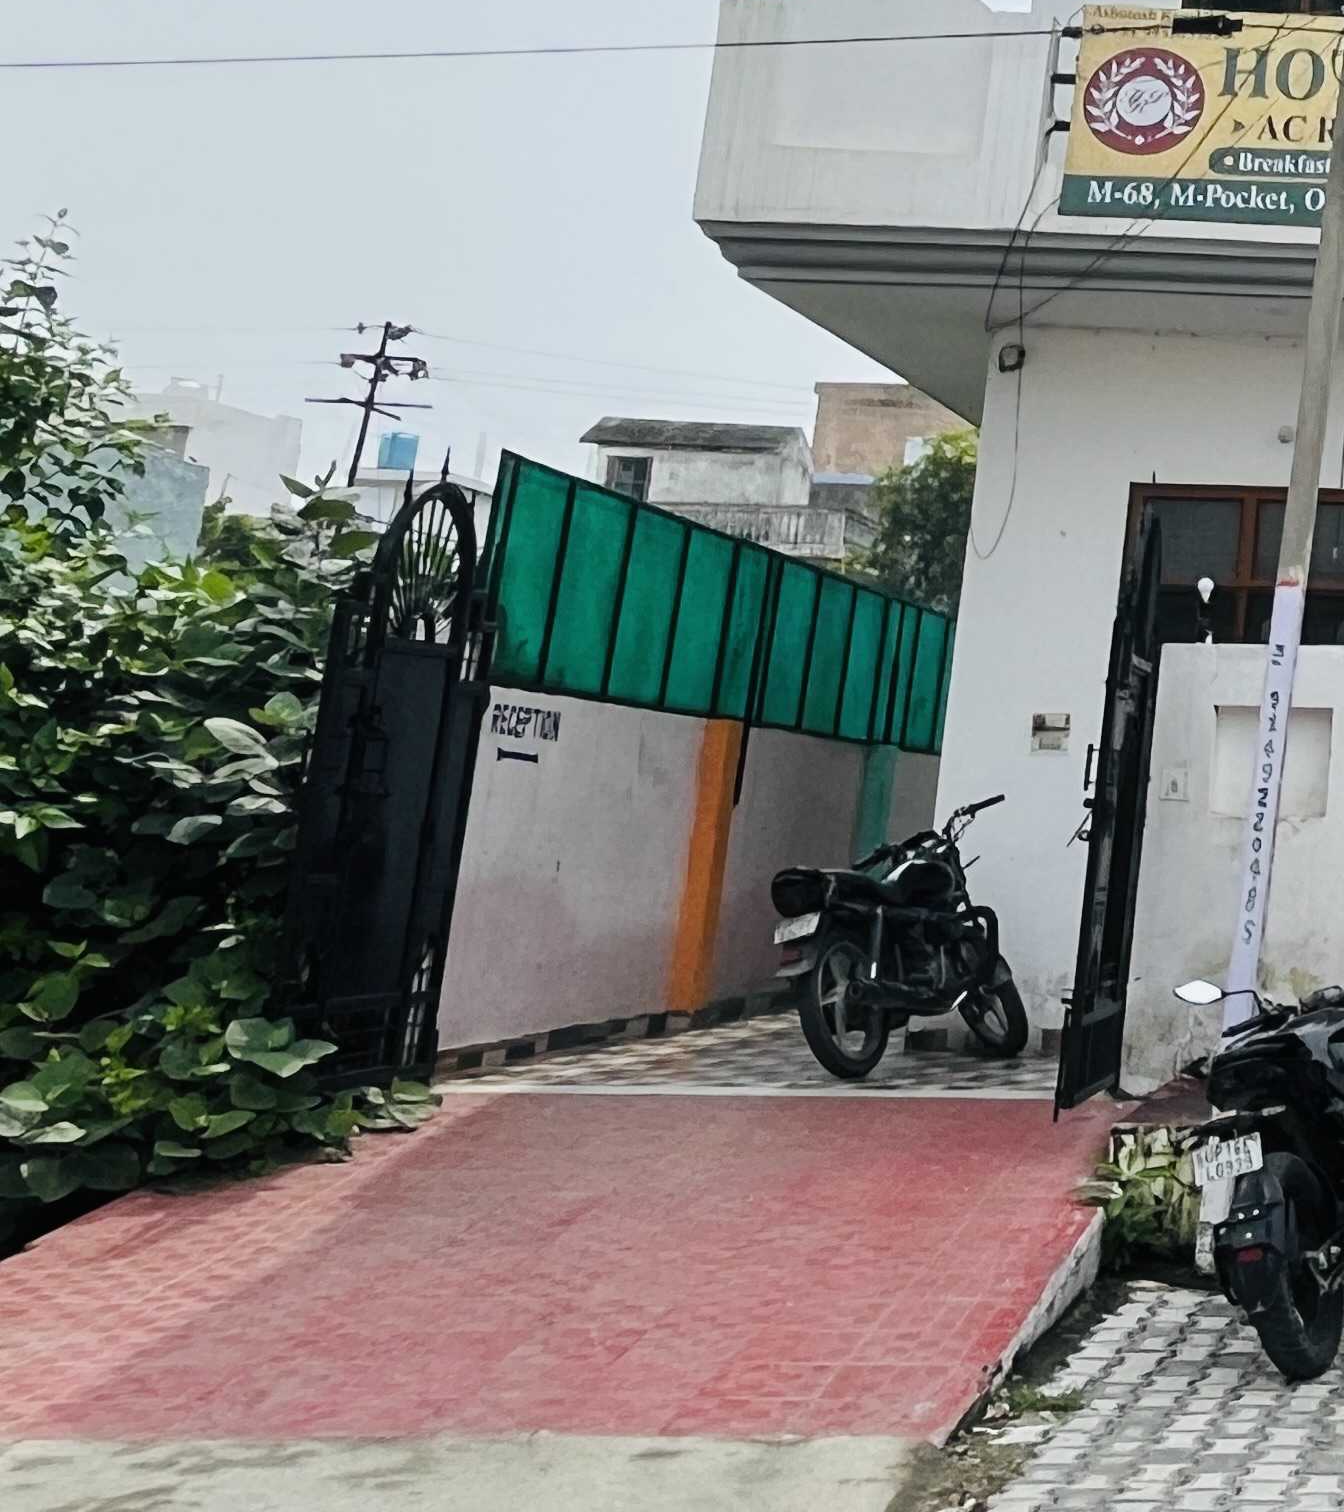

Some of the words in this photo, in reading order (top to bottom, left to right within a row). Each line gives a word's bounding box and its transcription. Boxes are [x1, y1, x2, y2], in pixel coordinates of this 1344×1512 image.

[1257, 114, 1307, 143] AC
[1238, 151, 1331, 174] Breakfast
[1087, 180, 1160, 210] M-68,
[1169, 182, 1295, 215] M-Pocket,
